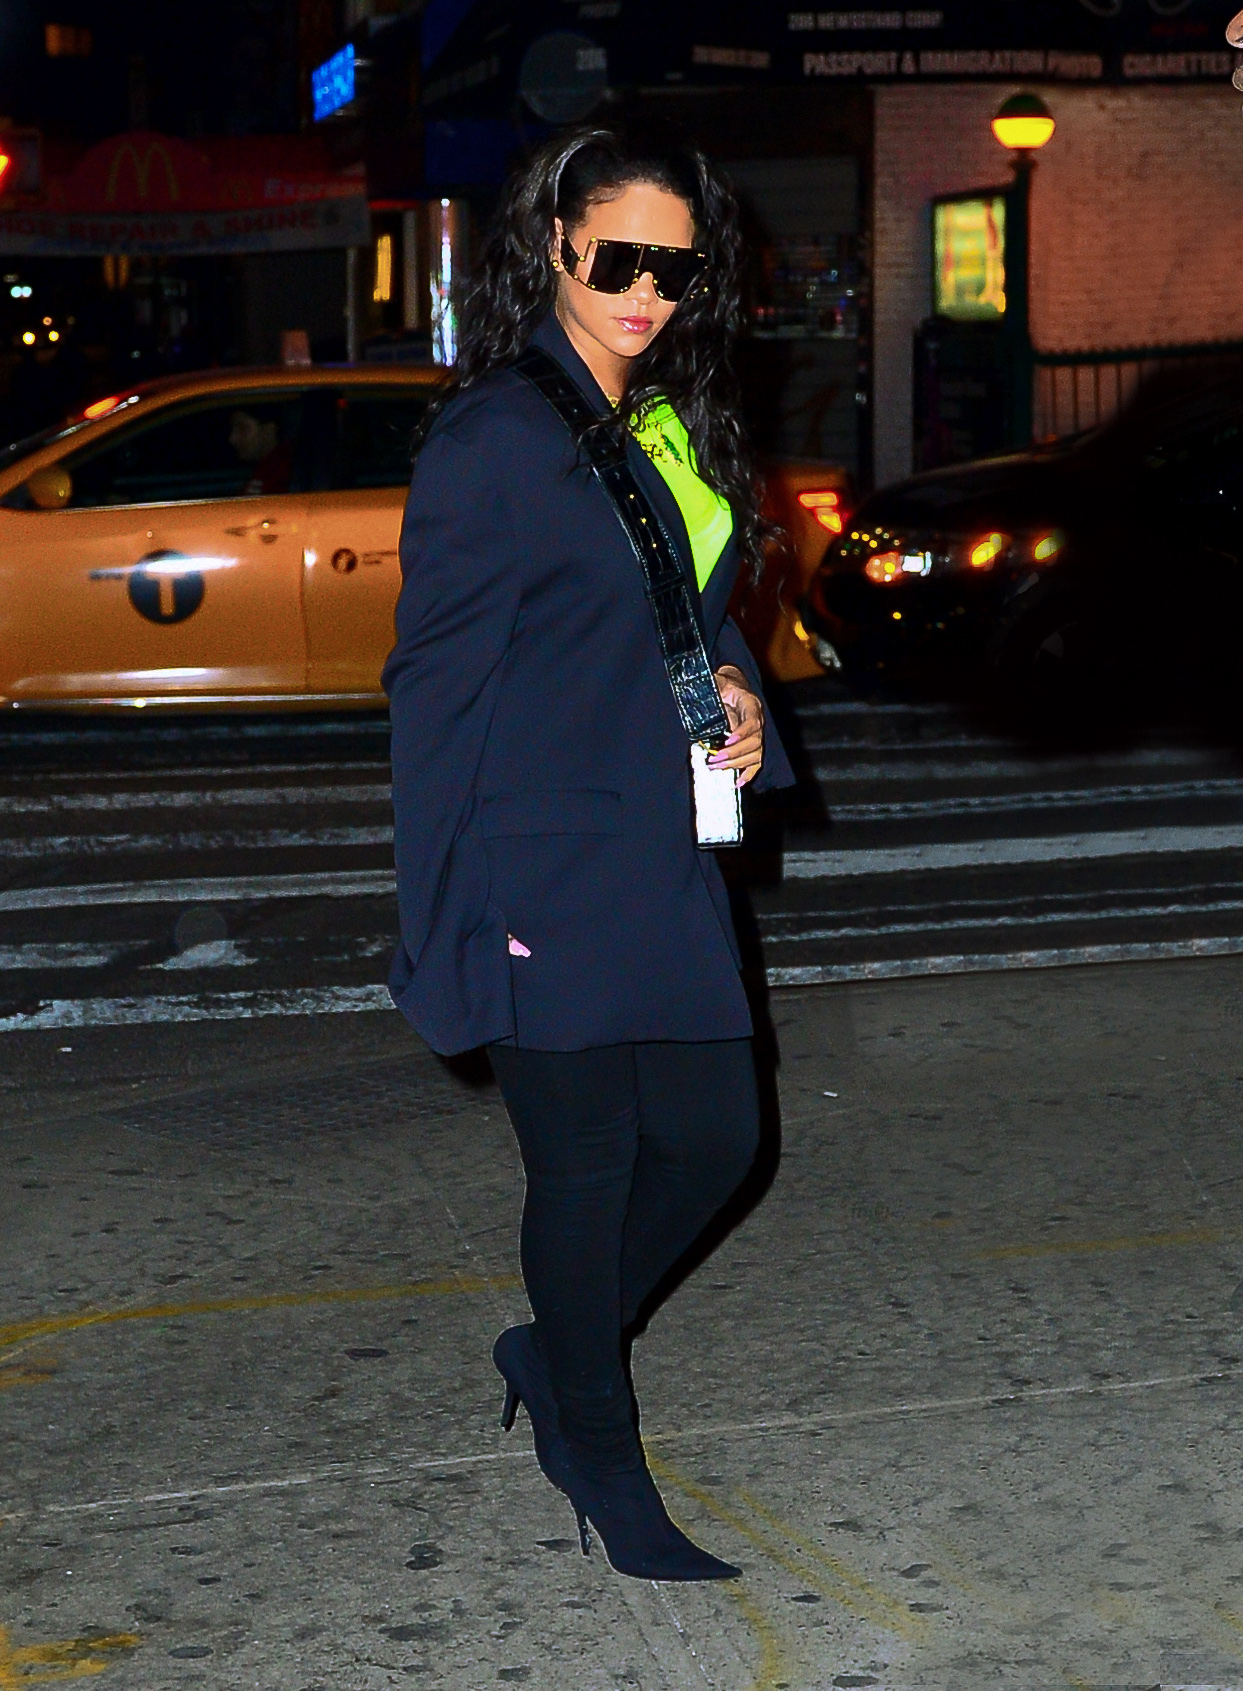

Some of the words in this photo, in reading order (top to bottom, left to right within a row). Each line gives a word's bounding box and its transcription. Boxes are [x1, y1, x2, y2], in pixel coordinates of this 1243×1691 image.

[803, 51, 897, 76] PASSPORT
[901, 50, 916, 75] &
[919, 48, 1044, 75] IMMIGRATION
[1121, 50, 1232, 77] CIGARETTES
[69, 218, 177, 241] REPAIR
[225, 207, 318, 233] SHINE
